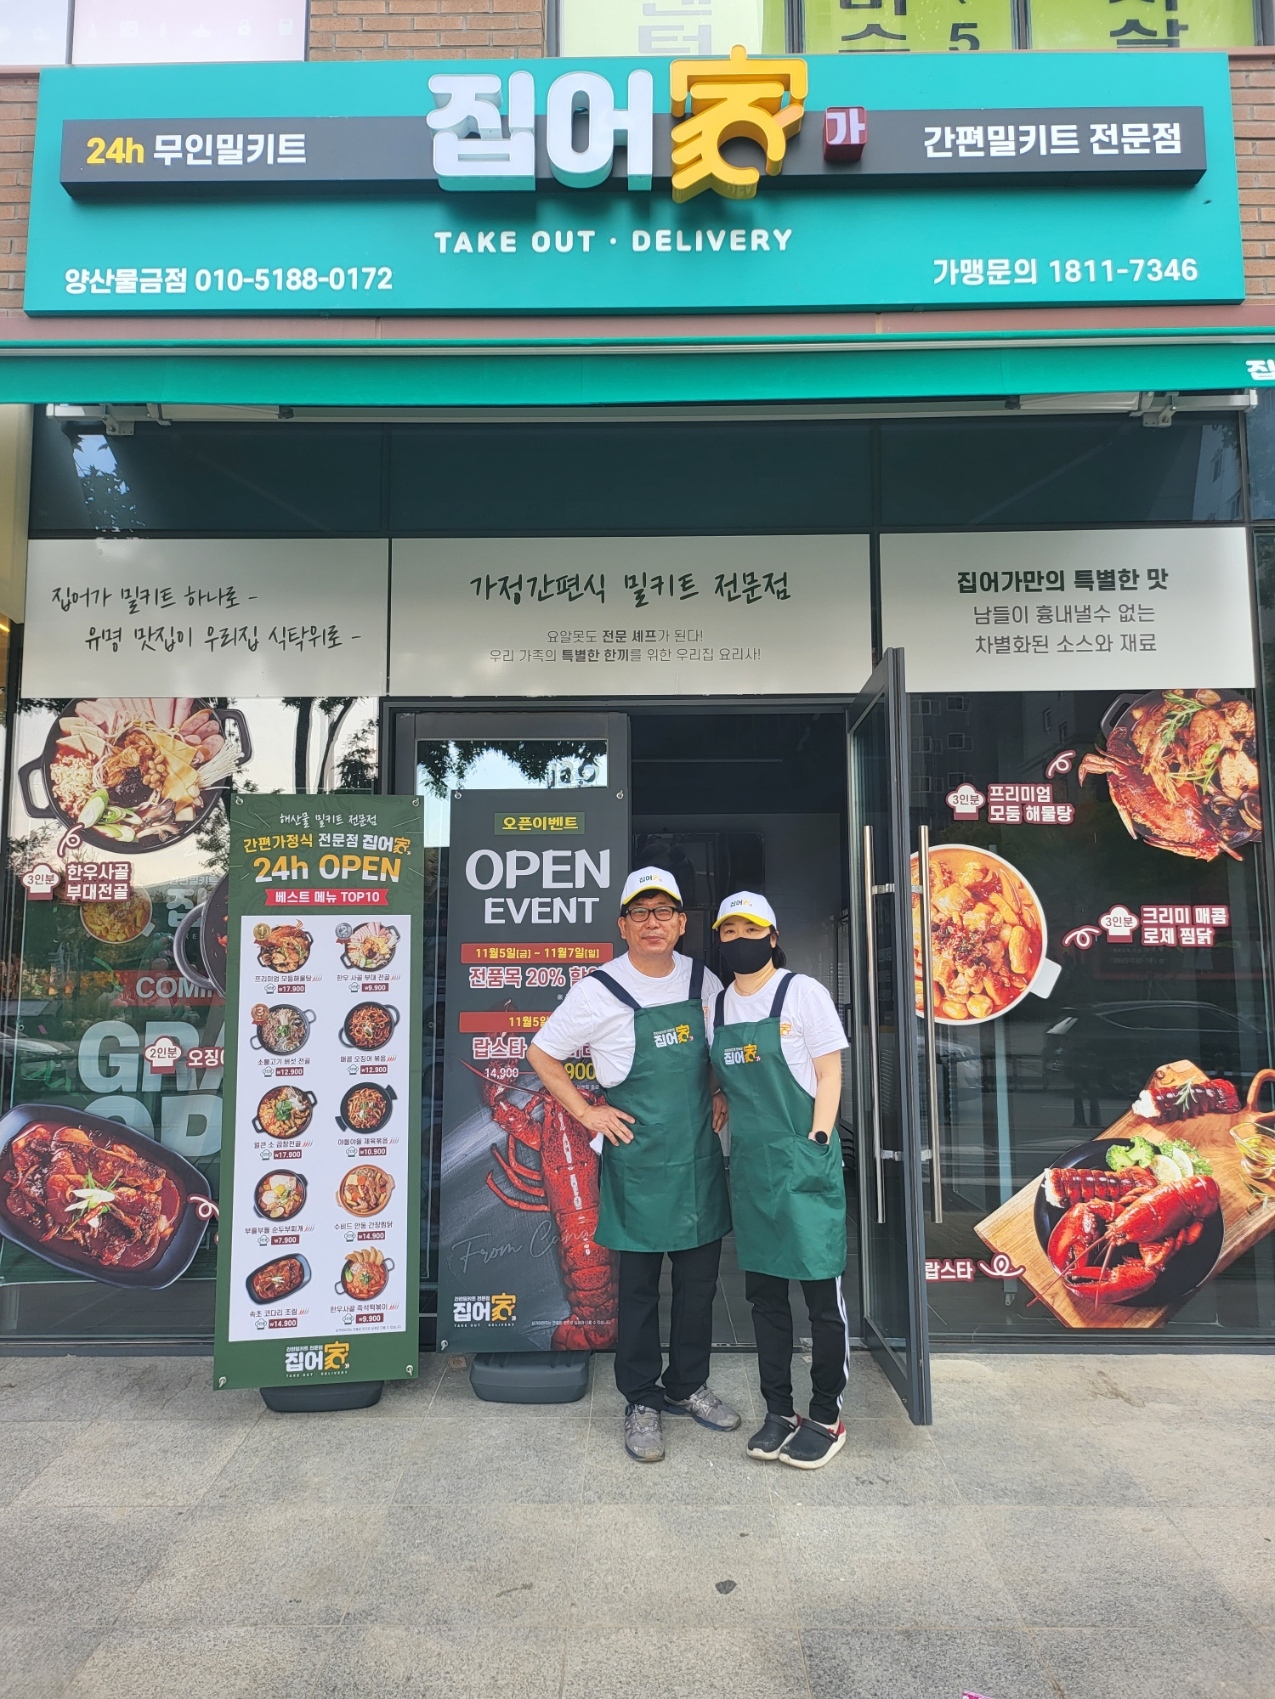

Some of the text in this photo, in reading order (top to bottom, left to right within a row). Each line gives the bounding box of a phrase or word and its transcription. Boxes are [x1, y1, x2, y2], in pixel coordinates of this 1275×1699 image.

[86, 133, 306, 166] 24h 무인밀키트
[924, 123, 1181, 158] 간편밀키트 전문점
[434, 229, 792, 253] TAKE OUT DELIVERY
[65, 267, 393, 294] 양산물금점 010-5188-0172
[933, 258, 1198, 286] 가맹문의 1811-7346
[470, 571, 792, 608] 가정간편식 밀키트 전문점
[957, 568, 1169, 593] 집어가만의 특별한 맛
[52, 585, 240, 614] 집어가 밀키트 하나로
[974, 603, 1155, 625] 남들이 흉내낼수 없는
[85, 624, 343, 652] 유명 맛집이 우리집 식탁위로
[547, 629, 703, 644] 요알못도 전문 셰프가 된다!
[975, 633, 1157, 654] 차별화된 소스와 재료
[489, 648, 761, 662] 우리 가족의 특별한 한끼를 위한 우리집 요리사!
[952, 794, 980, 805] 3인분
[990, 786, 1050, 803] 프리미엄
[315, 813, 344, 828] 밀키트
[348, 814, 378, 827] 전문점
[502, 816, 579, 830] 오픈이벤트
[990, 805, 1073, 822] 모둠 해물탕
[243, 833, 313, 853] 간편가정식
[318, 833, 358, 849] 전문점
[67, 864, 129, 881] 한우사골
[253, 854, 402, 882] 24h OPEN
[465, 849, 610, 890] OPEN
[27, 874, 55, 884] 3인분
[66, 883, 129, 900] 부대전골
[275, 891, 380, 903] 베스트 메뉴 TOP10
[484, 897, 599, 924] EVENT
[1143, 908, 1227, 924] 크리미 매콤
[1105, 916, 1133, 928] 3인분
[1144, 927, 1213, 944] 로제 찜닭
[469, 966, 522, 988] 전품목
[526, 967, 566, 988] 20%
[150, 1047, 177, 1058] 2인분
[452, 1233, 522, 1273] From
